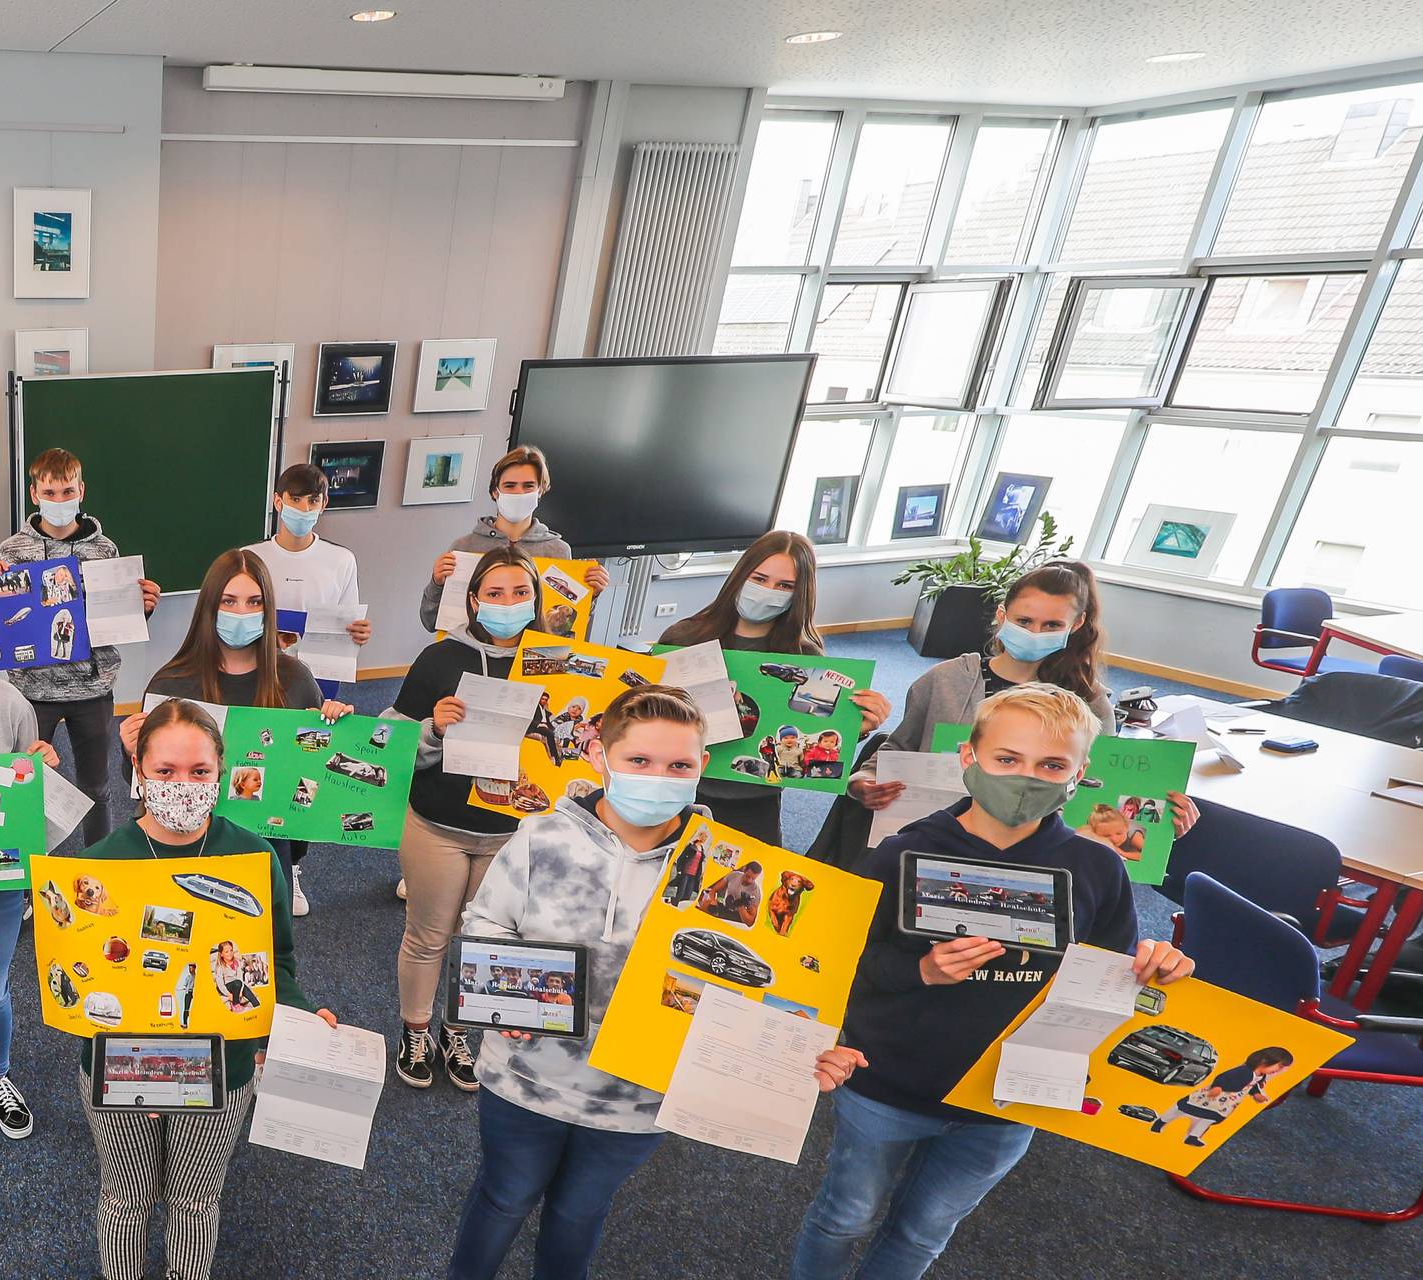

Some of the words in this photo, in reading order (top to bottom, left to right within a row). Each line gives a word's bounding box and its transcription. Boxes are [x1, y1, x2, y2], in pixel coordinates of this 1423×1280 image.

[824, 670, 853, 688] NETFLIX
[354, 743, 380, 755] Sport
[1108, 754, 1151, 771] JOB
[324, 773, 368, 796] Haustiere
[340, 832, 367, 842] Auto
[993, 970, 1043, 982] HAVEN
